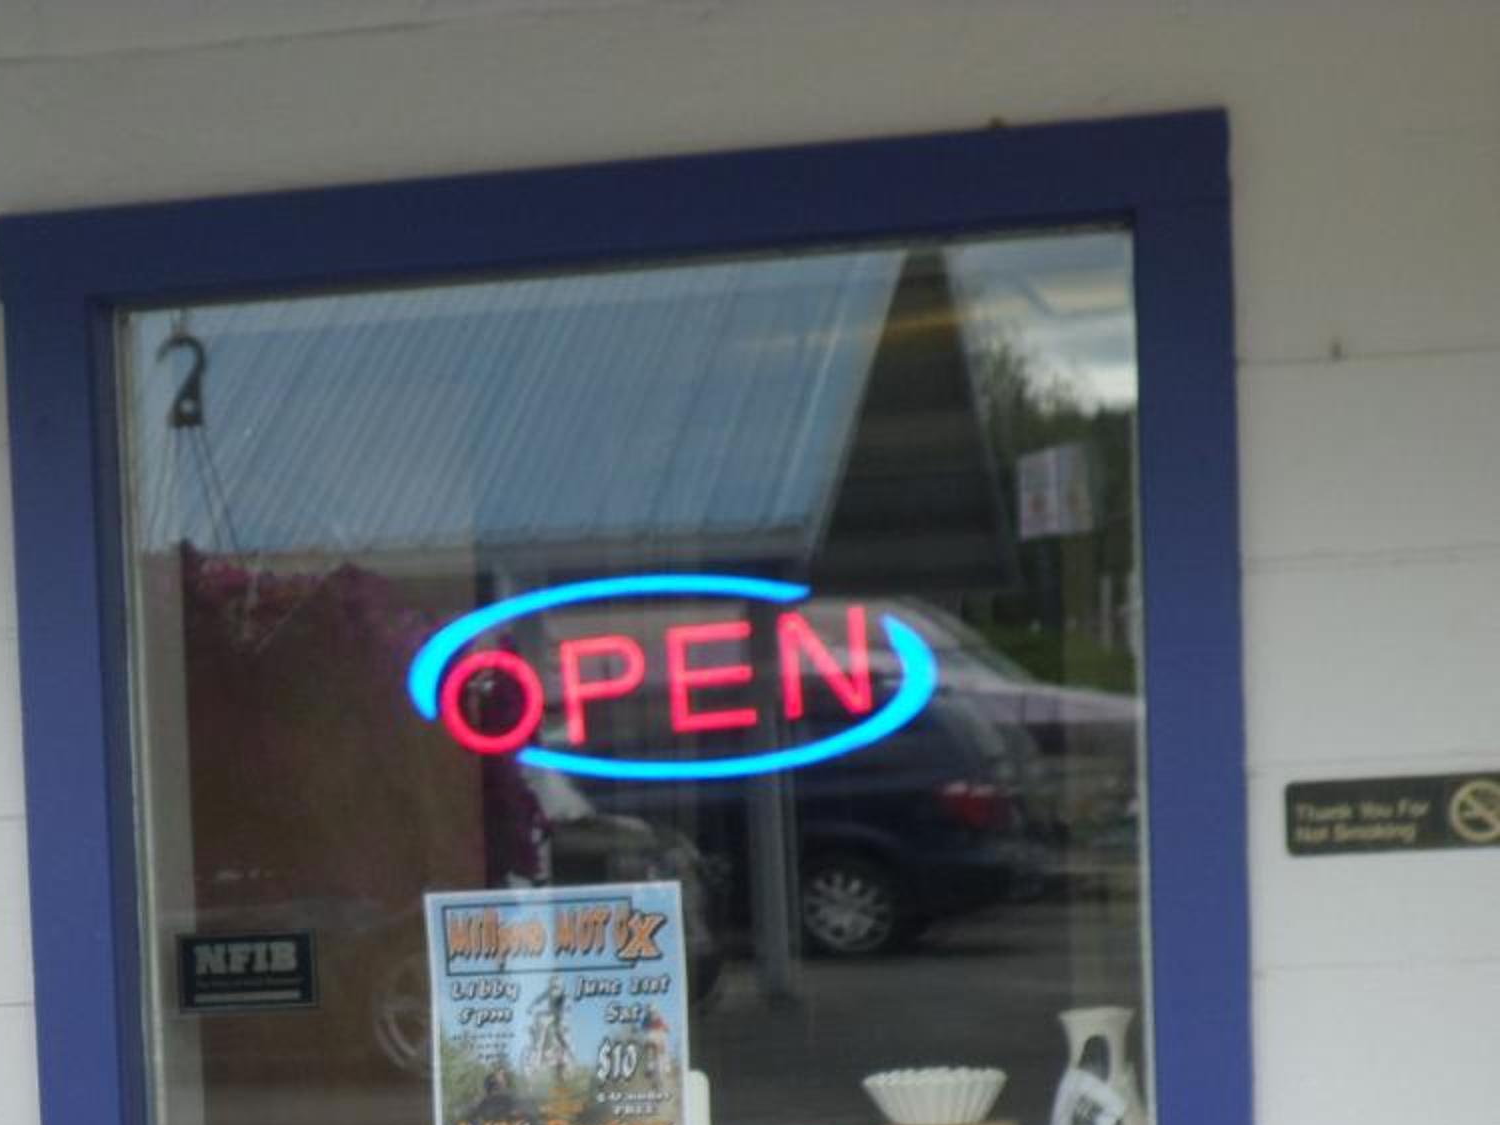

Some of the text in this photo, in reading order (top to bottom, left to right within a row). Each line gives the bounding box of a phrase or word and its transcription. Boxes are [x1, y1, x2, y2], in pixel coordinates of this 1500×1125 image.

[440, 604, 873, 755] OPEN
[1295, 798, 1430, 821] Thank You For
[1295, 822, 1417, 843] Not Smoking
[194, 941, 298, 976] NFIB
[575, 976, 622, 1000] June
[596, 1036, 638, 1081] $10
